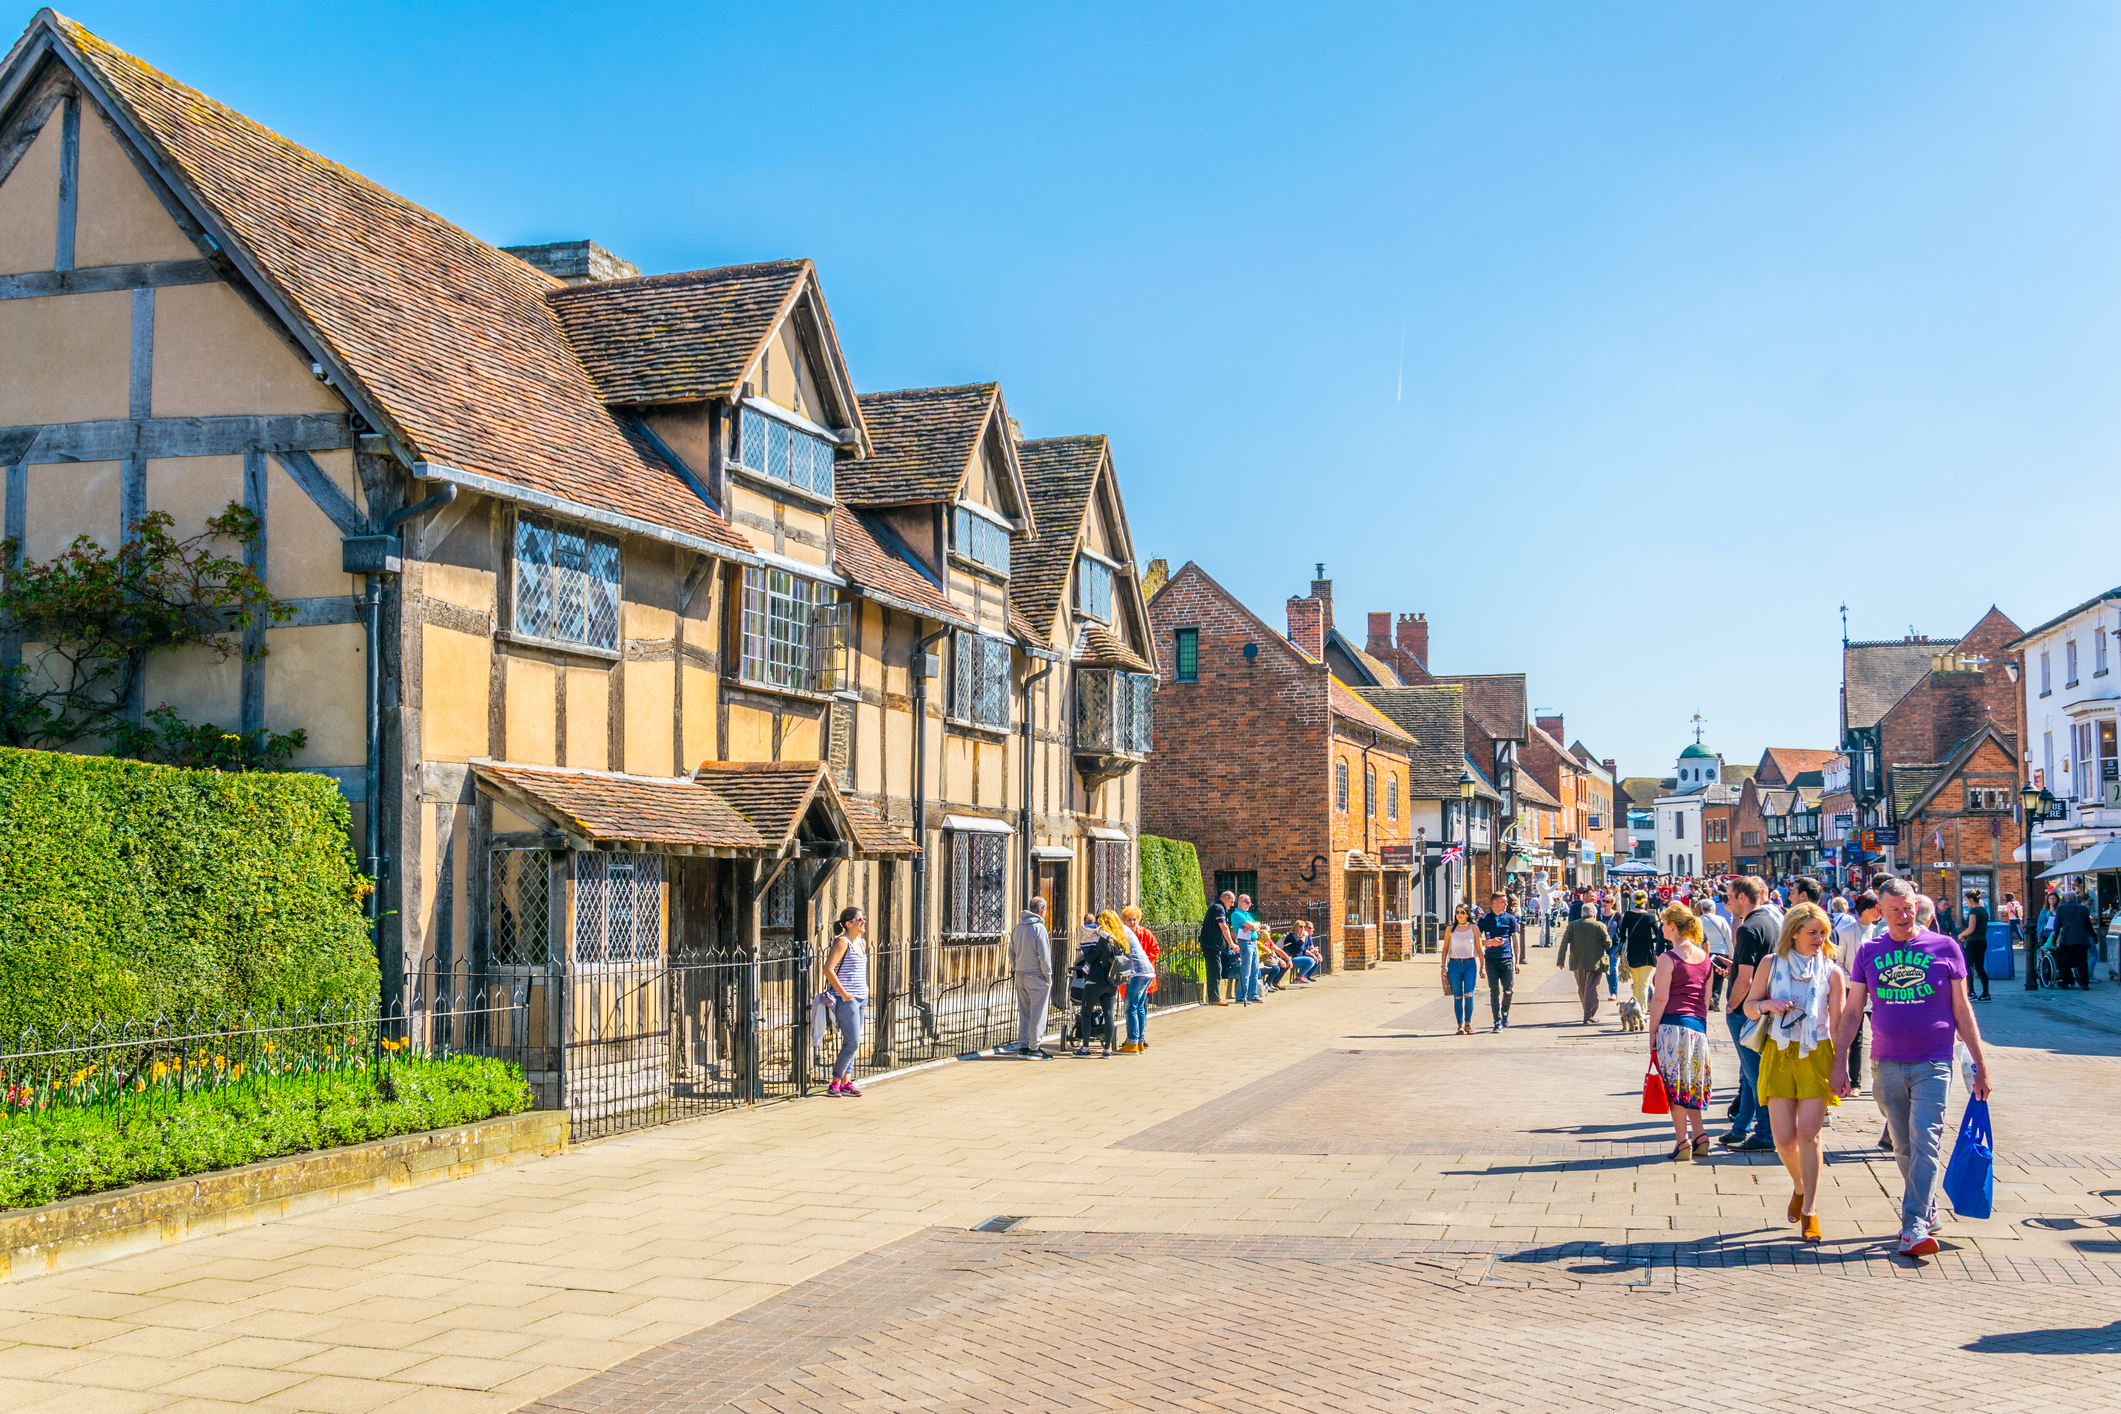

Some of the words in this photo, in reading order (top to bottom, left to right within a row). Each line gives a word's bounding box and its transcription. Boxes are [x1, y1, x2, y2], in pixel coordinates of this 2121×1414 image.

[1874, 950, 1934, 969] GARAGE
[1879, 968, 1924, 983] Superdry
[1876, 987, 1915, 1000] MOTOR
[1916, 984, 1936, 997] CO.
